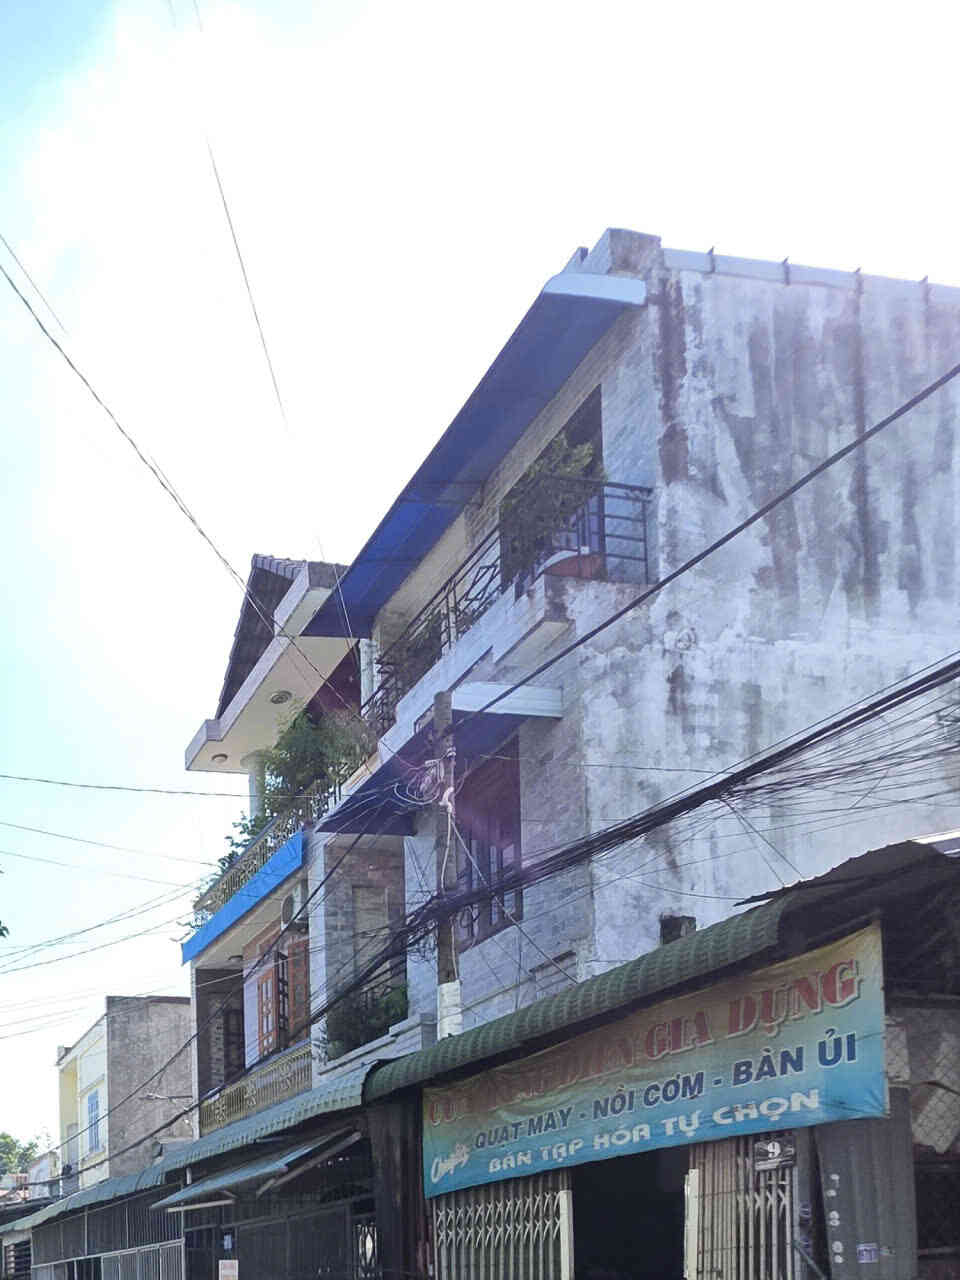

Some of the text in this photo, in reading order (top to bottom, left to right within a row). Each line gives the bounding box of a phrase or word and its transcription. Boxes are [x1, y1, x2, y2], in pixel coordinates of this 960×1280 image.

[645, 1010, 714, 1062] GIA
[727, 958, 863, 1038] DỤNG
[643, 1071, 705, 1107] CƠM
[732, 1046, 804, 1087] BÀN
[817, 1026, 858, 1067] ỦI
[539, 1137, 585, 1163] TẠP
[591, 1122, 651, 1151] HÓA
[660, 1108, 703, 1137] TỰ
[711, 1088, 821, 1125] CHỌN
[766, 1140, 782, 1159] 9
